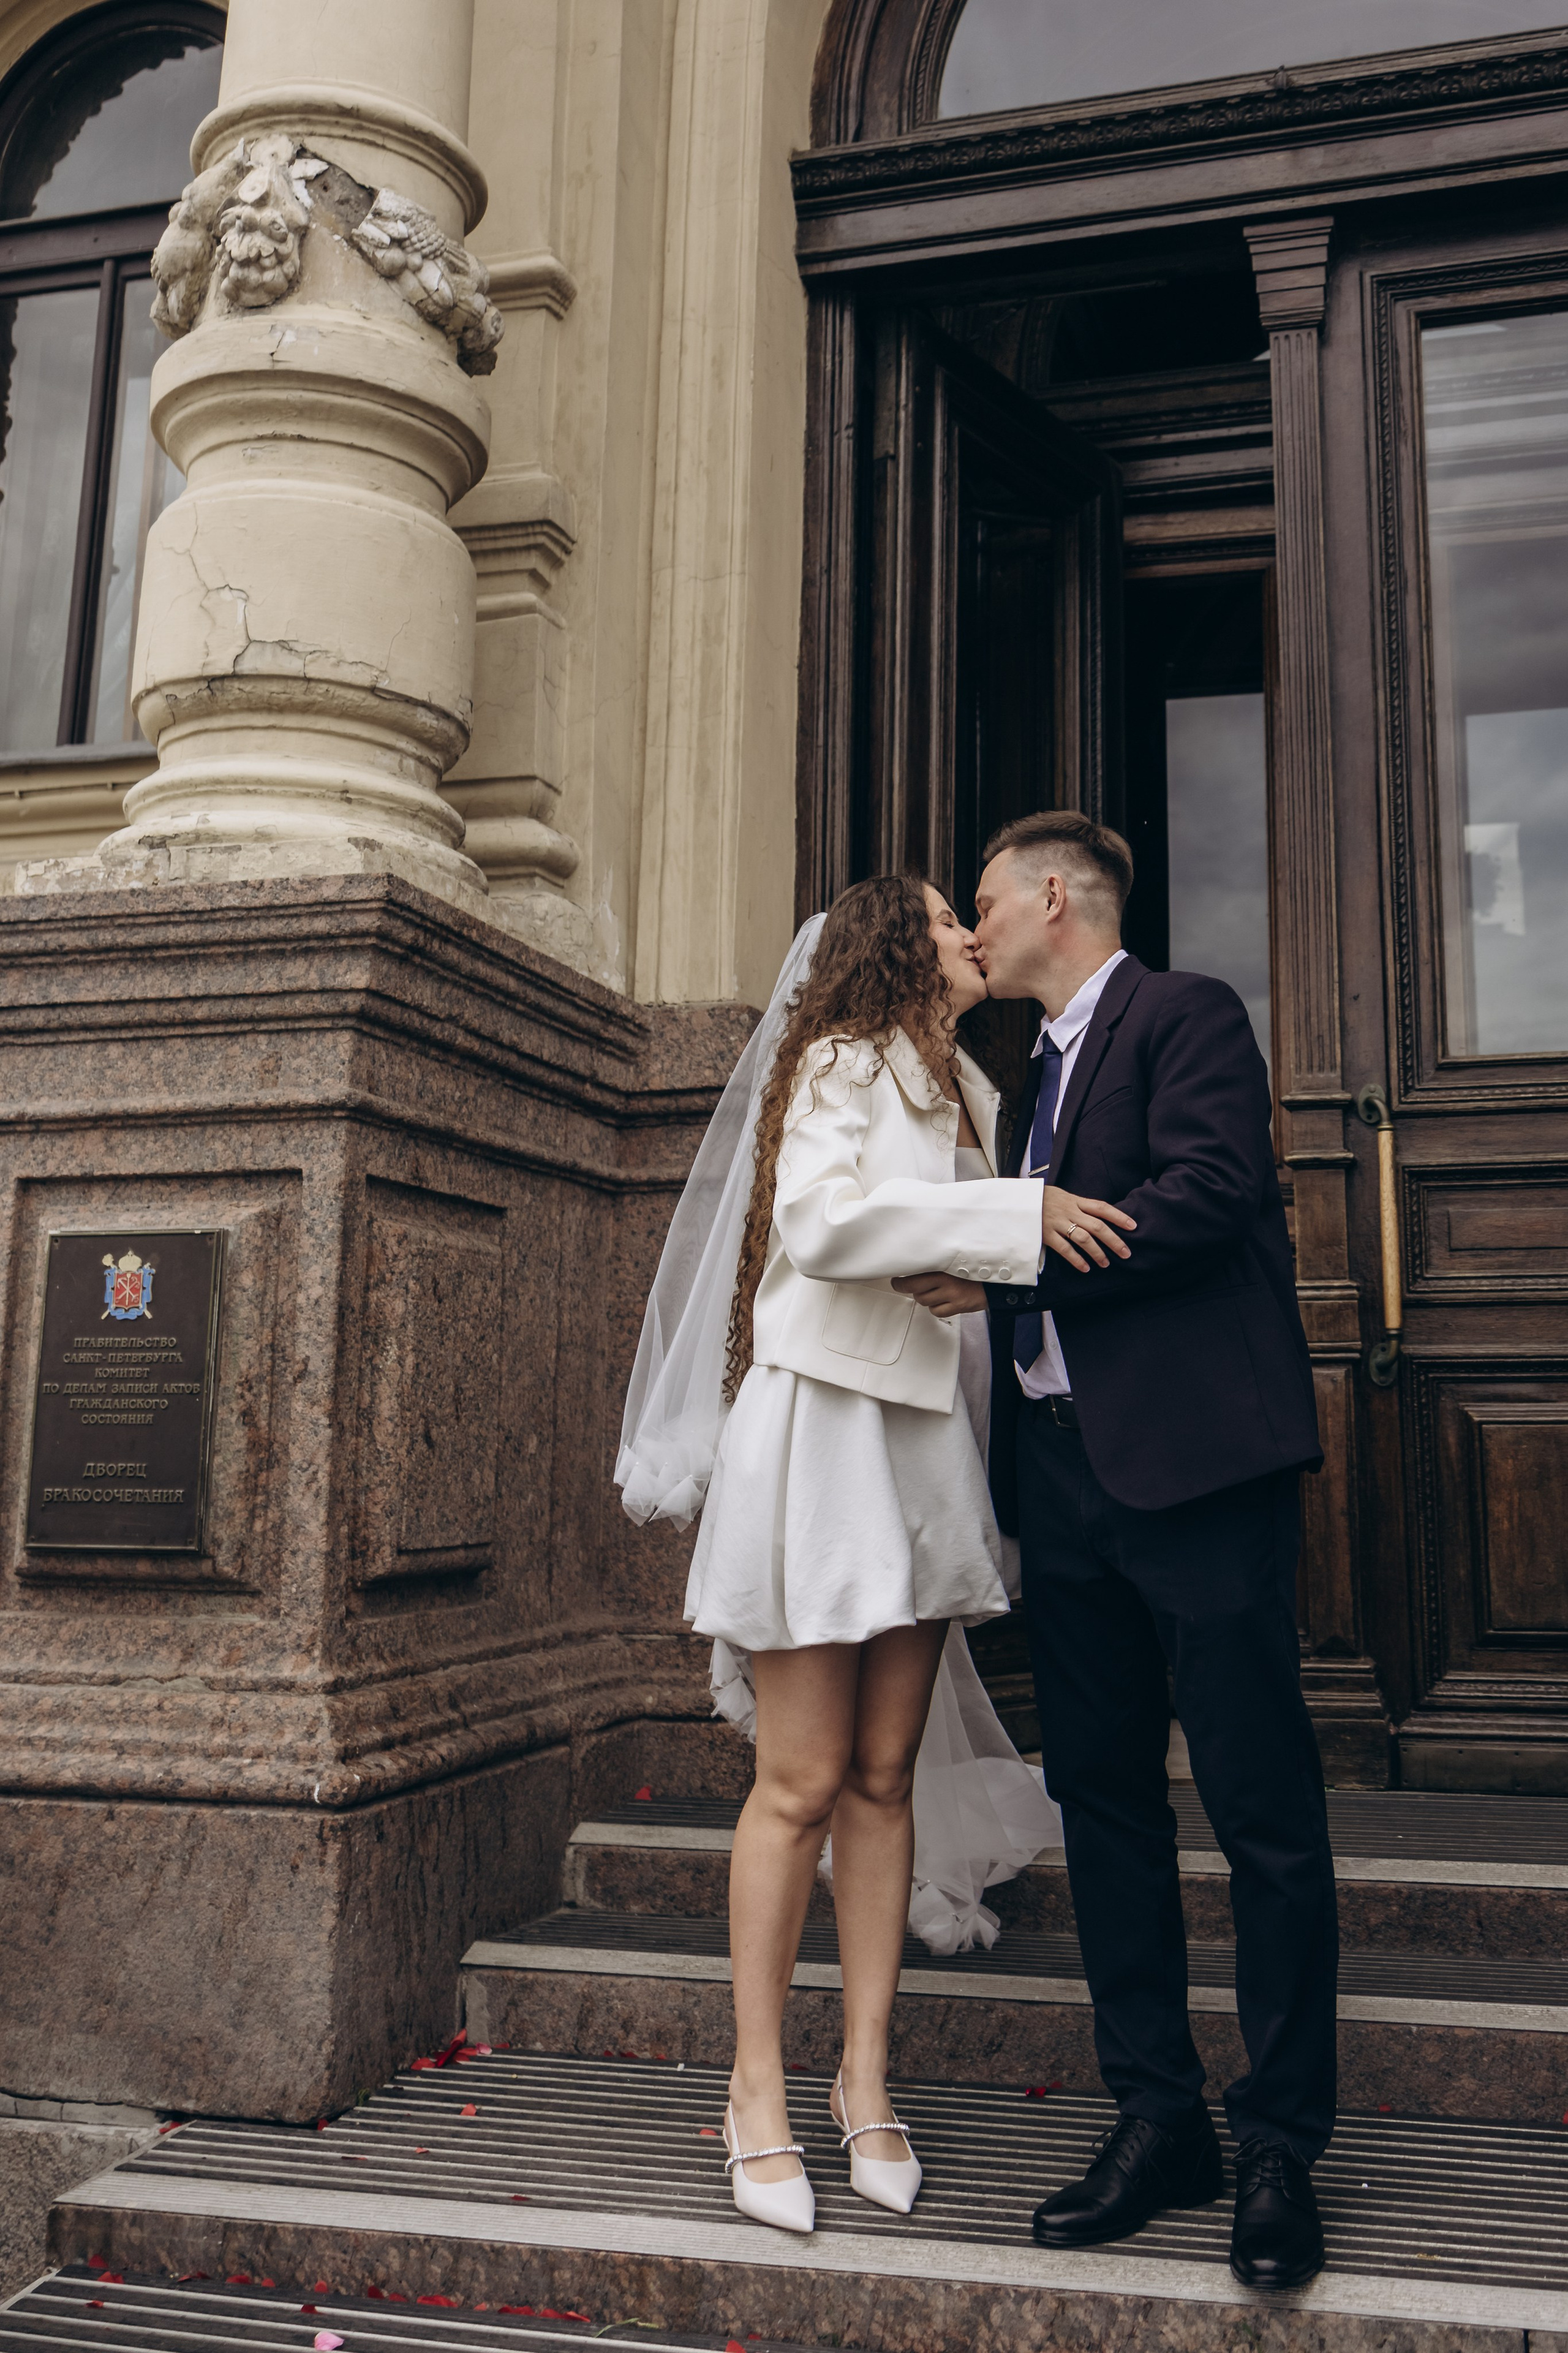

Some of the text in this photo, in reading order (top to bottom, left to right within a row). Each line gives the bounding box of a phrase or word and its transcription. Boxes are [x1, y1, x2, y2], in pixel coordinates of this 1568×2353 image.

[74, 1337, 176, 1348] ПРАВИТЕЛЬСТВО
[63, 1353, 183, 1364] САНКТ-ПЕТЕРБУРГА
[95, 1368, 150, 1378] КОМИТЕТ
[43, 1383, 200, 1394] ПО ДЕЛАМ ЗАПИСИ АКТОВ
[70, 1399, 168, 1409] ГРАЖДАНСКОГО
[81, 1414, 154, 1424] СОСТОЯНИЯ
[83, 1463, 147, 1478] ДВОРЕЦ
[43, 1489, 184, 1503] БРАКОСОЧЕТАНИЯ
